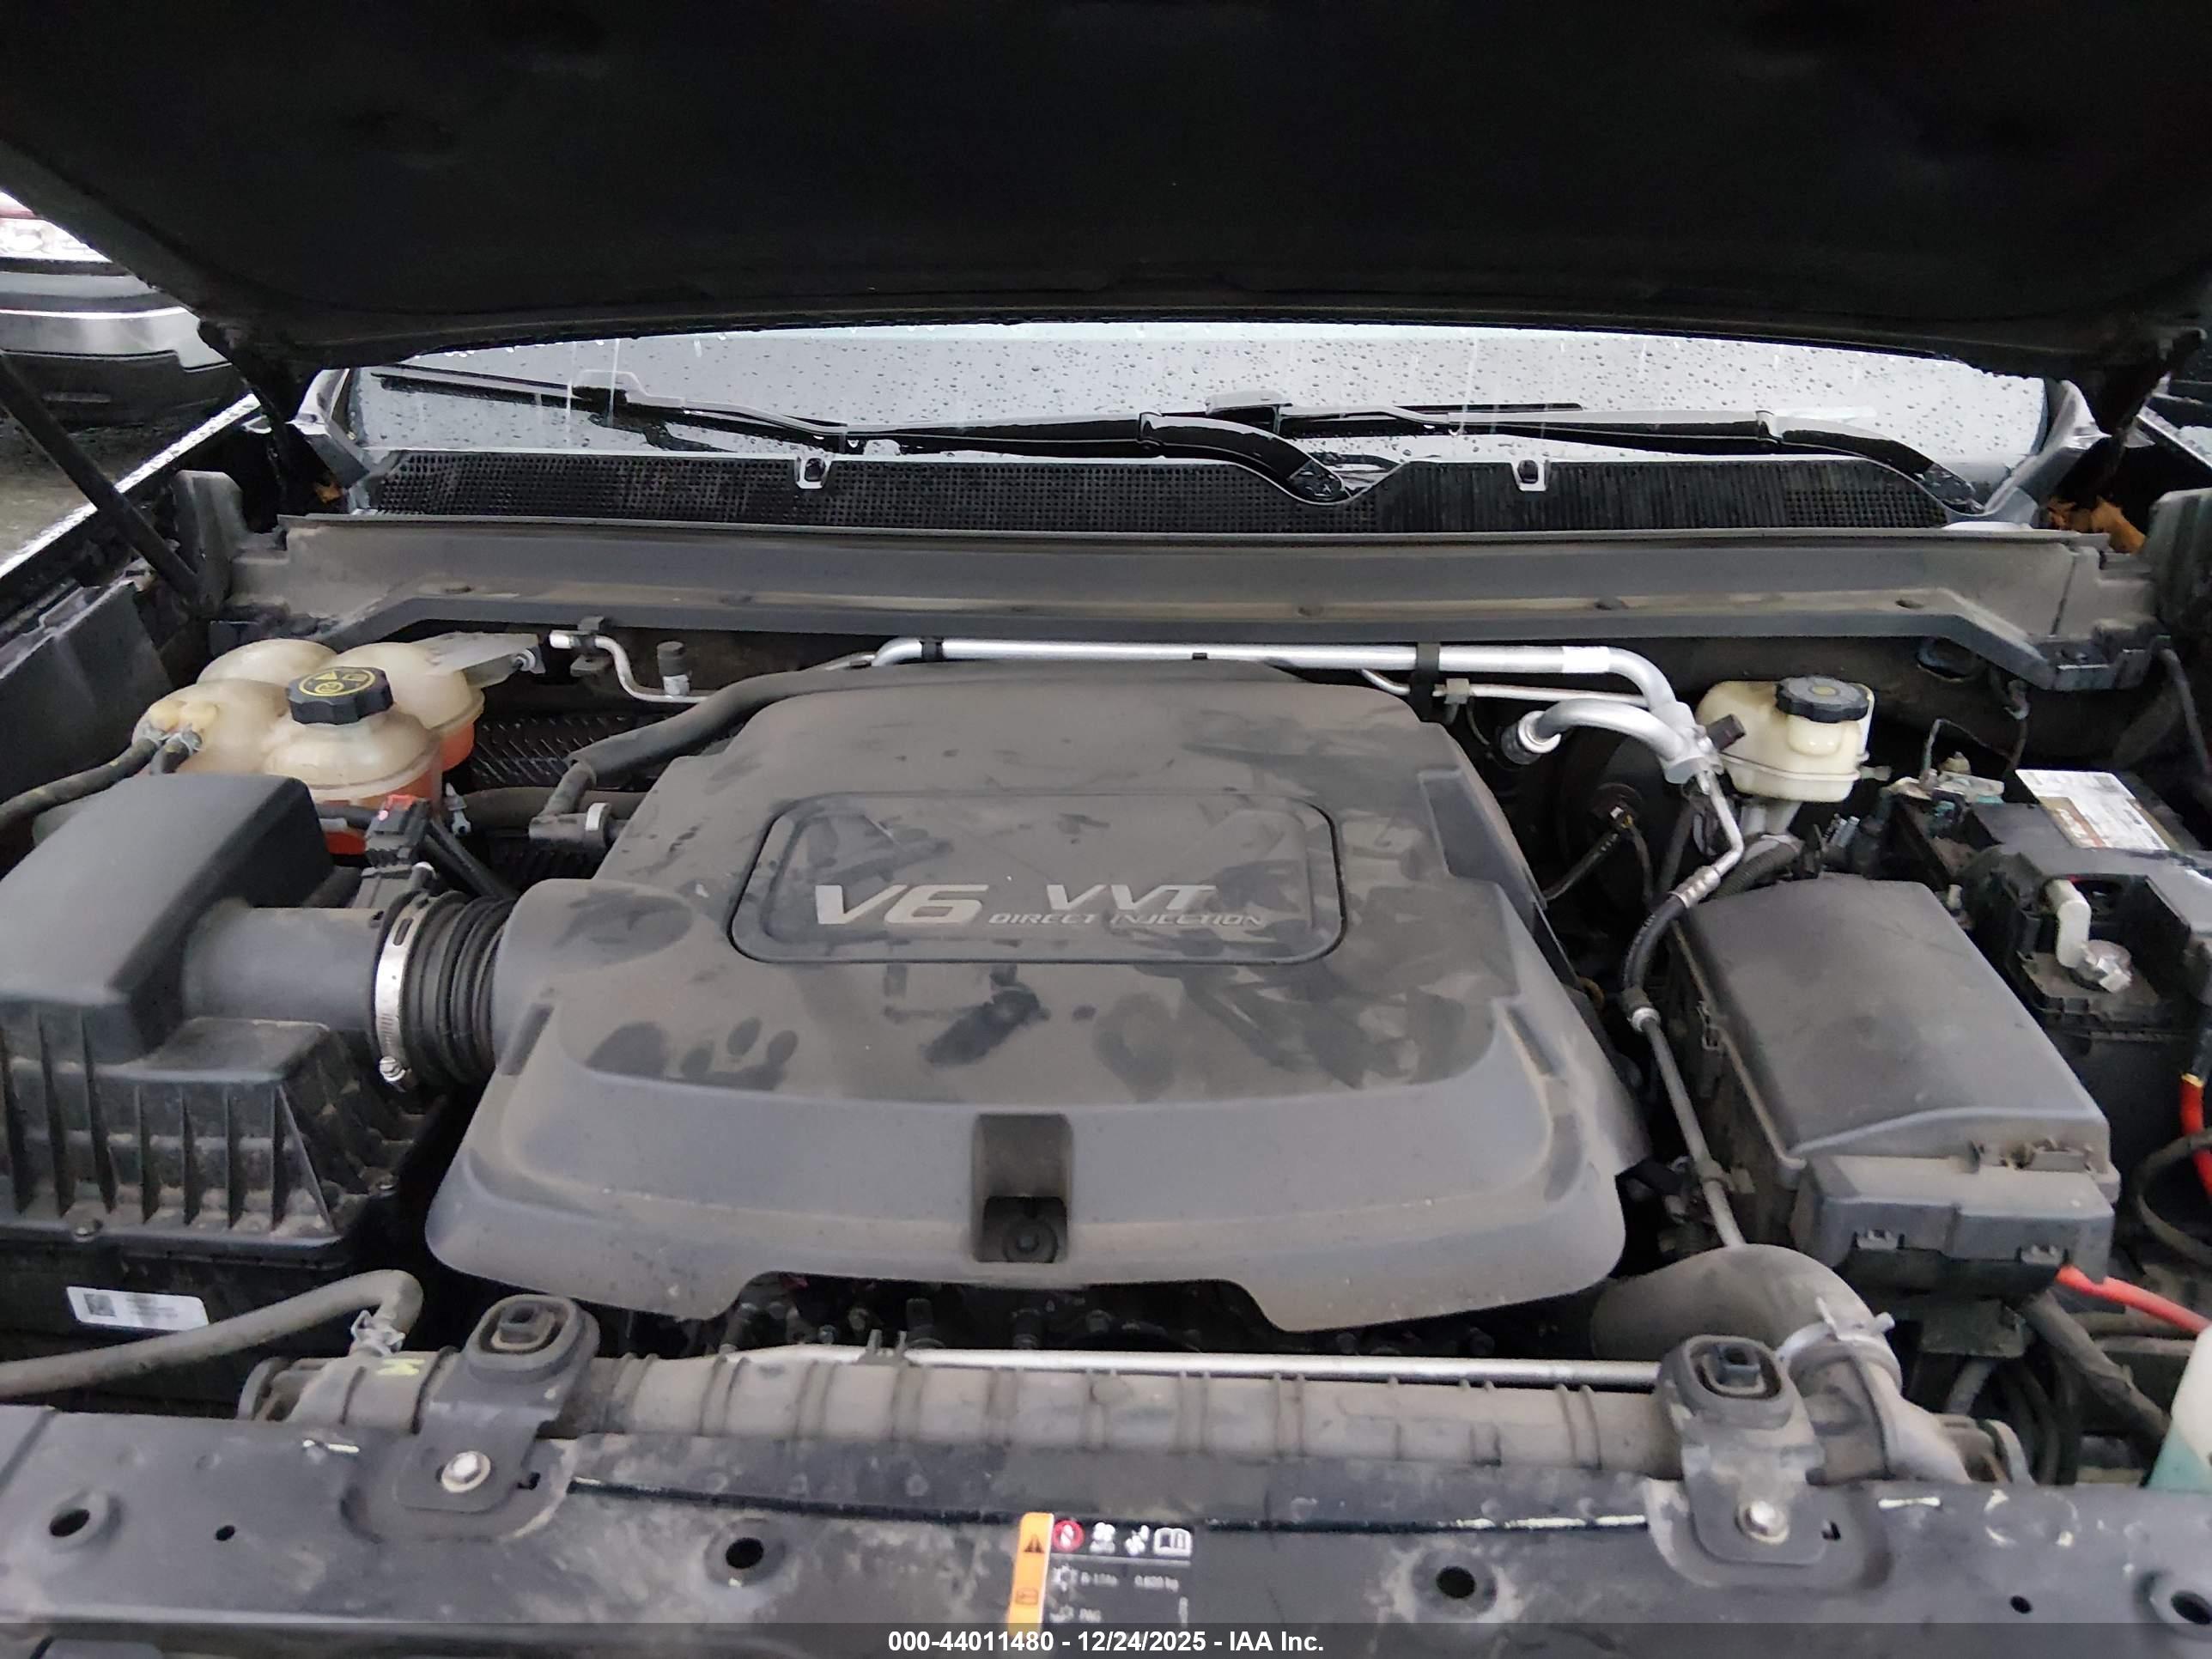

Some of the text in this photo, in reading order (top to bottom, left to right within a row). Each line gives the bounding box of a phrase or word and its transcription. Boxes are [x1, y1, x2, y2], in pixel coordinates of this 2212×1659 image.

[816, 884, 1217, 925] V6 VVT
[988, 912, 1097, 925] DIRECT
